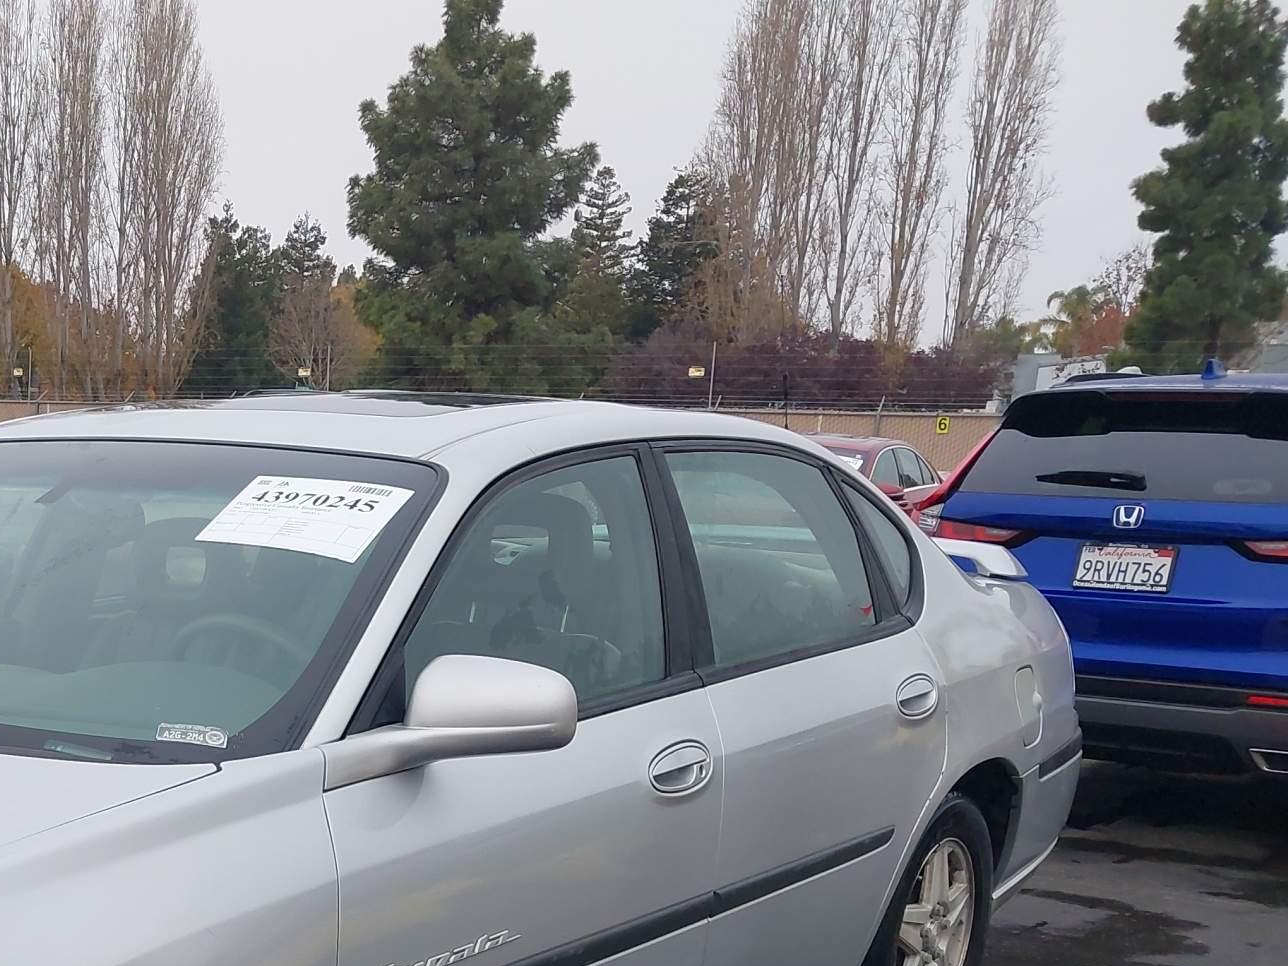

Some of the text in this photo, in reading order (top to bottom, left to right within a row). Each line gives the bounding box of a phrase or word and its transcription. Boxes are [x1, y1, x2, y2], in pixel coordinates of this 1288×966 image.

[938, 418, 947, 430] 6
[252, 490, 381, 513] 43970245
[1098, 547, 1157, 560] California
[1079, 559, 1168, 584] 9RVH756
